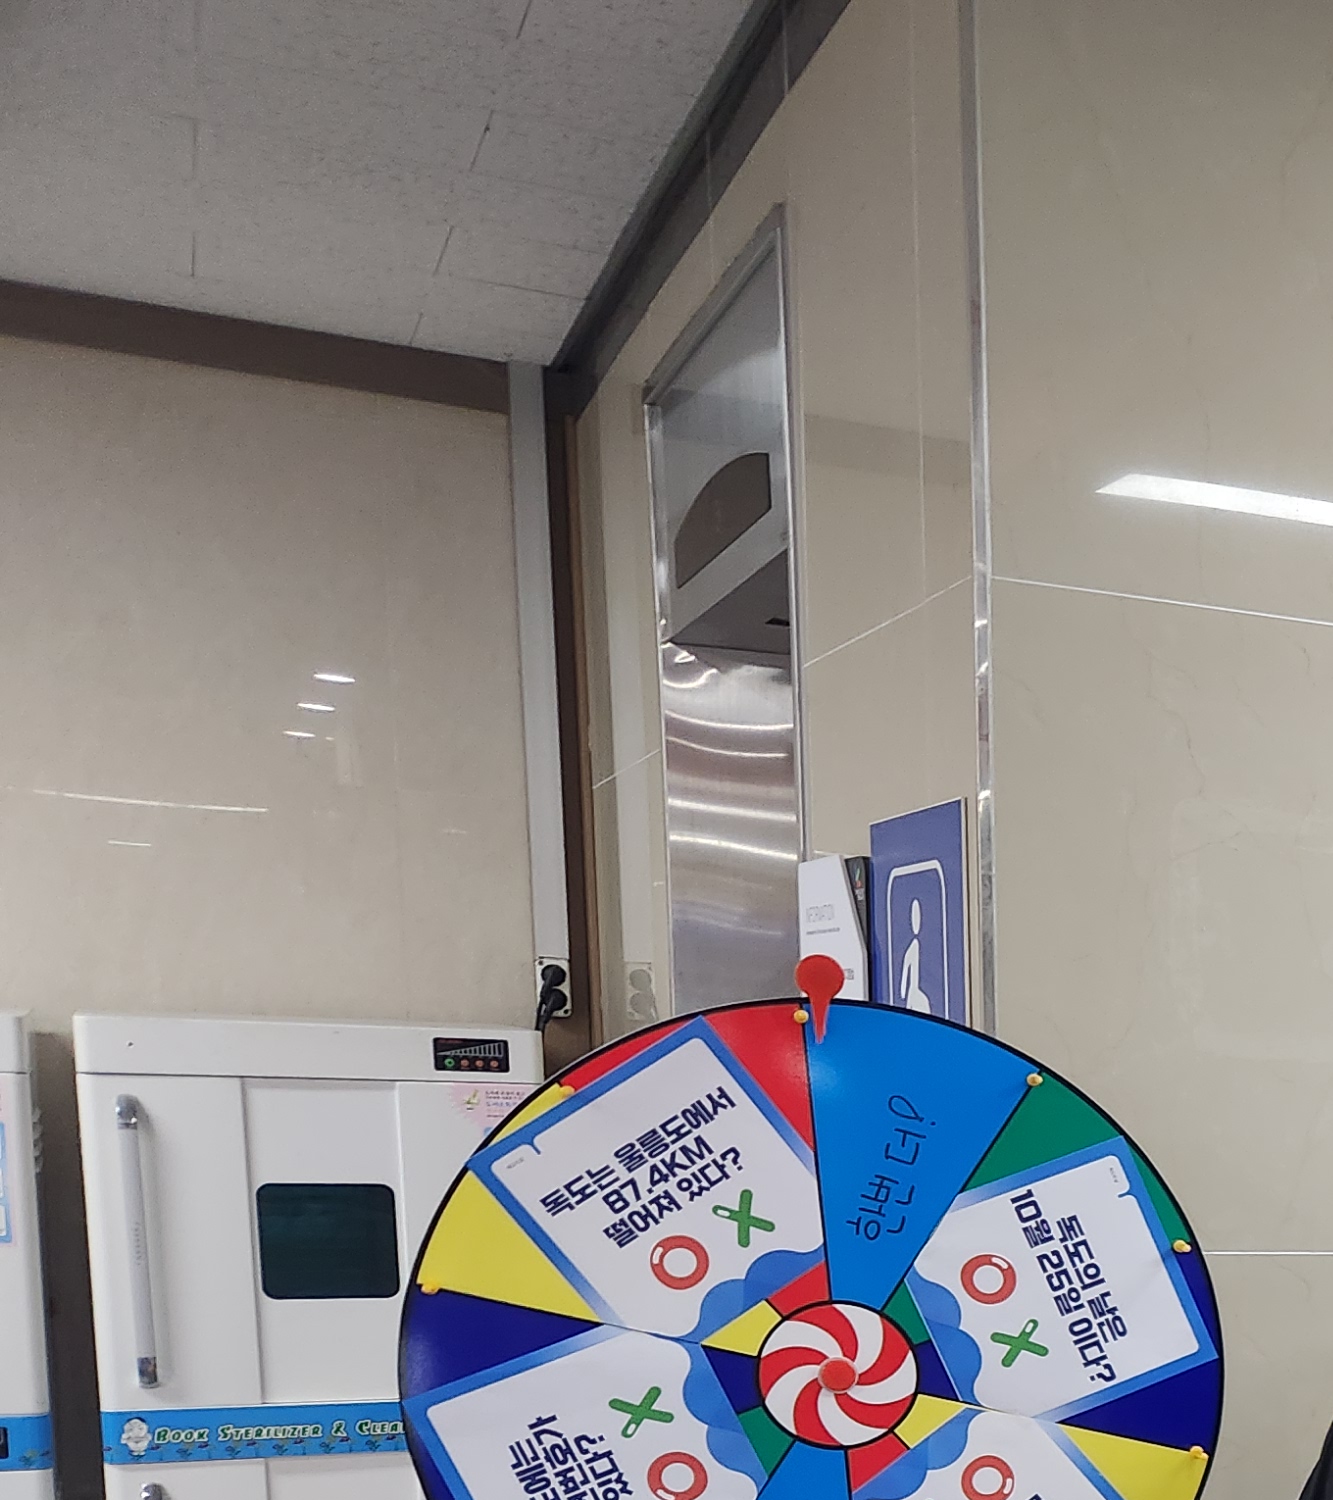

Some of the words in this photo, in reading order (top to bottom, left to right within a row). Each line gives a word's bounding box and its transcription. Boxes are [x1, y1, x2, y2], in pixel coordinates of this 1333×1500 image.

[539, 1164, 620, 1217] 독도는
[614, 1086, 736, 1174] 울릉도에서
[602, 1135, 715, 1214] 87.4KM
[603, 1189, 682, 1248] 떨어져
[676, 1147, 743, 1202] 있다?
[1010, 1189, 1055, 1248] 10월
[1036, 1250, 1087, 1317] 25일
[1068, 1317, 1116, 1382] 이다?
[1056, 1215, 1106, 1291] 독도의
[1087, 1291, 1127, 1344] 날은
[354, 1420, 405, 1435] CLEA
